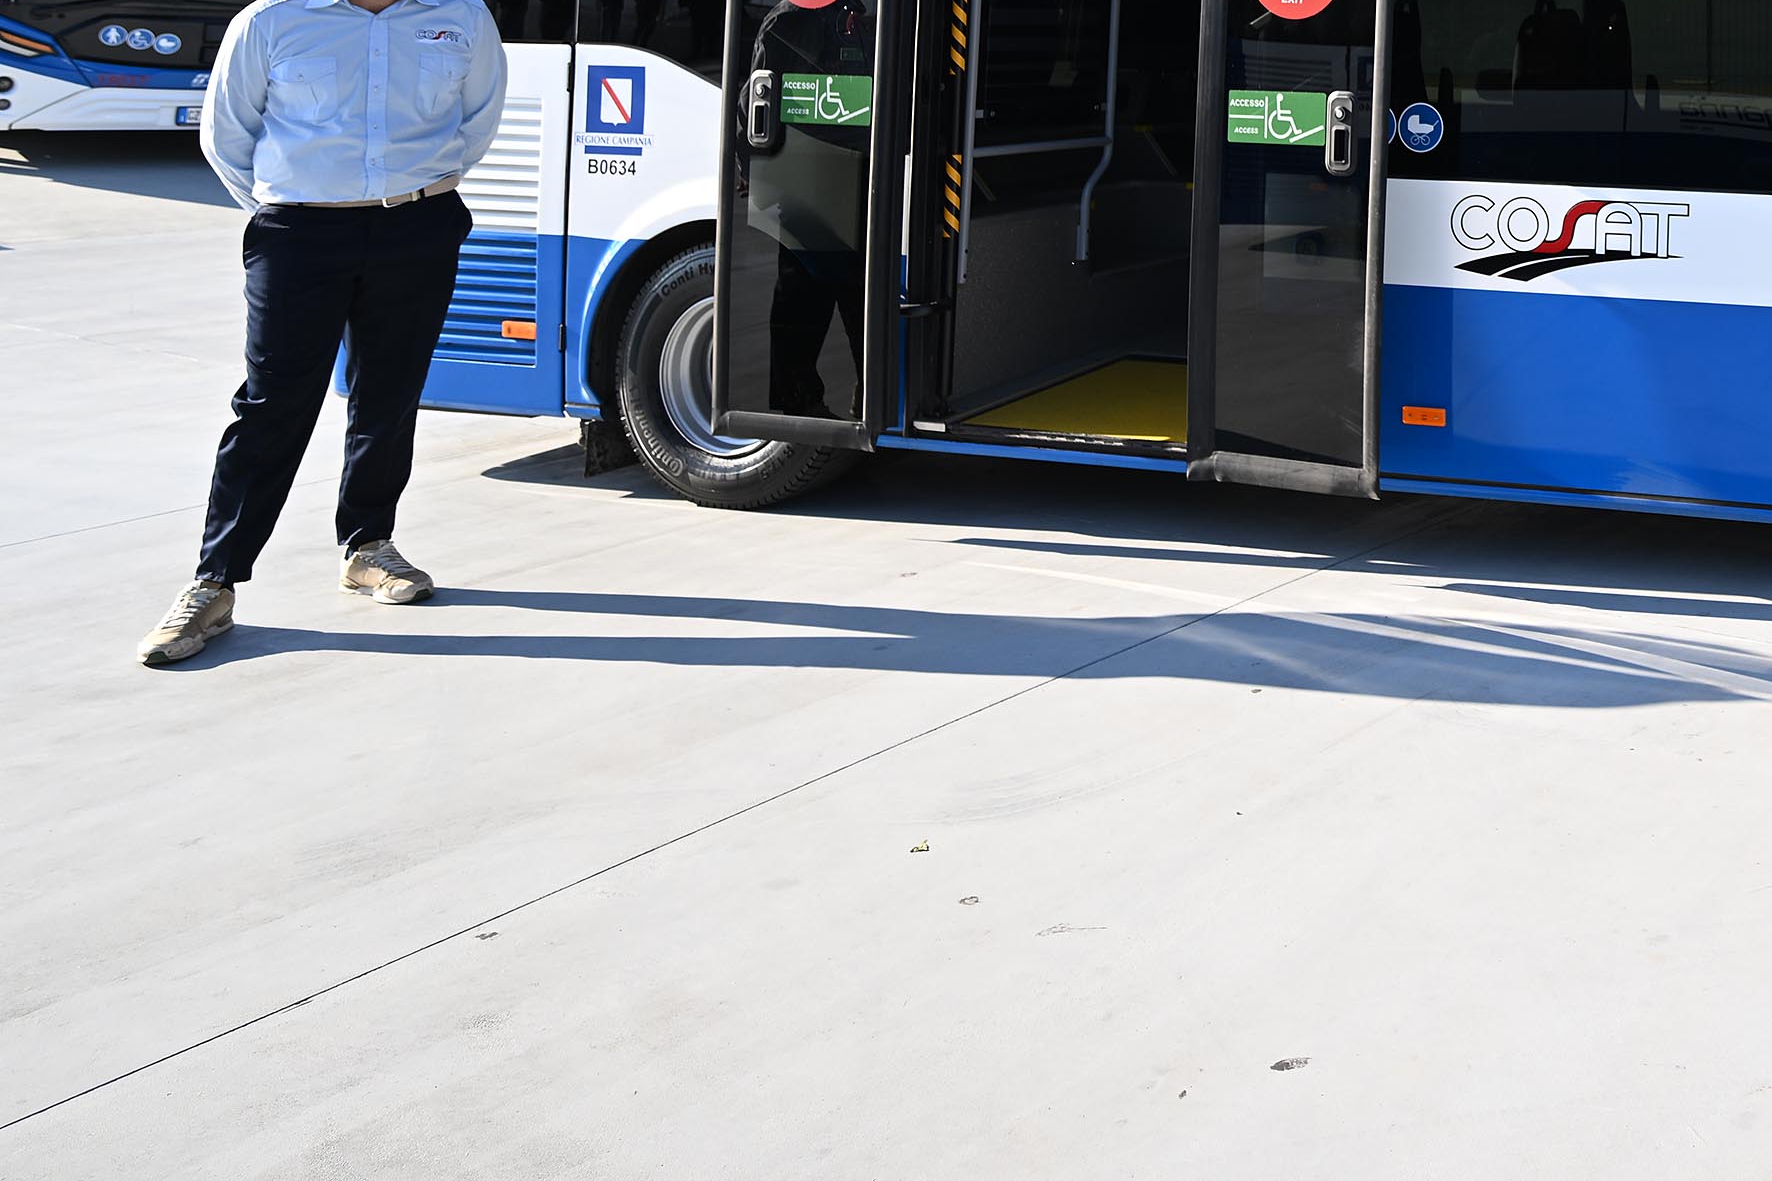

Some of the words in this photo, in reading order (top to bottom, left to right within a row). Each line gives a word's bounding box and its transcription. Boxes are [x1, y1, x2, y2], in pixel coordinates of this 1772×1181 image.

[416, 29, 462, 42] COSAT
[783, 81, 815, 90] ACCESSO
[1229, 98, 1265, 109] ACCESSO
[787, 107, 810, 115] ACCESS
[1233, 126, 1259, 135] ACCESS
[576, 135, 610, 144] REGIONE
[612, 135, 652, 146] CAMPANIA
[588, 159, 636, 176] B0634
[1450, 194, 1690, 259] COSAT
[661, 266, 694, 296] Conti
[629, 398, 683, 477] Continental
